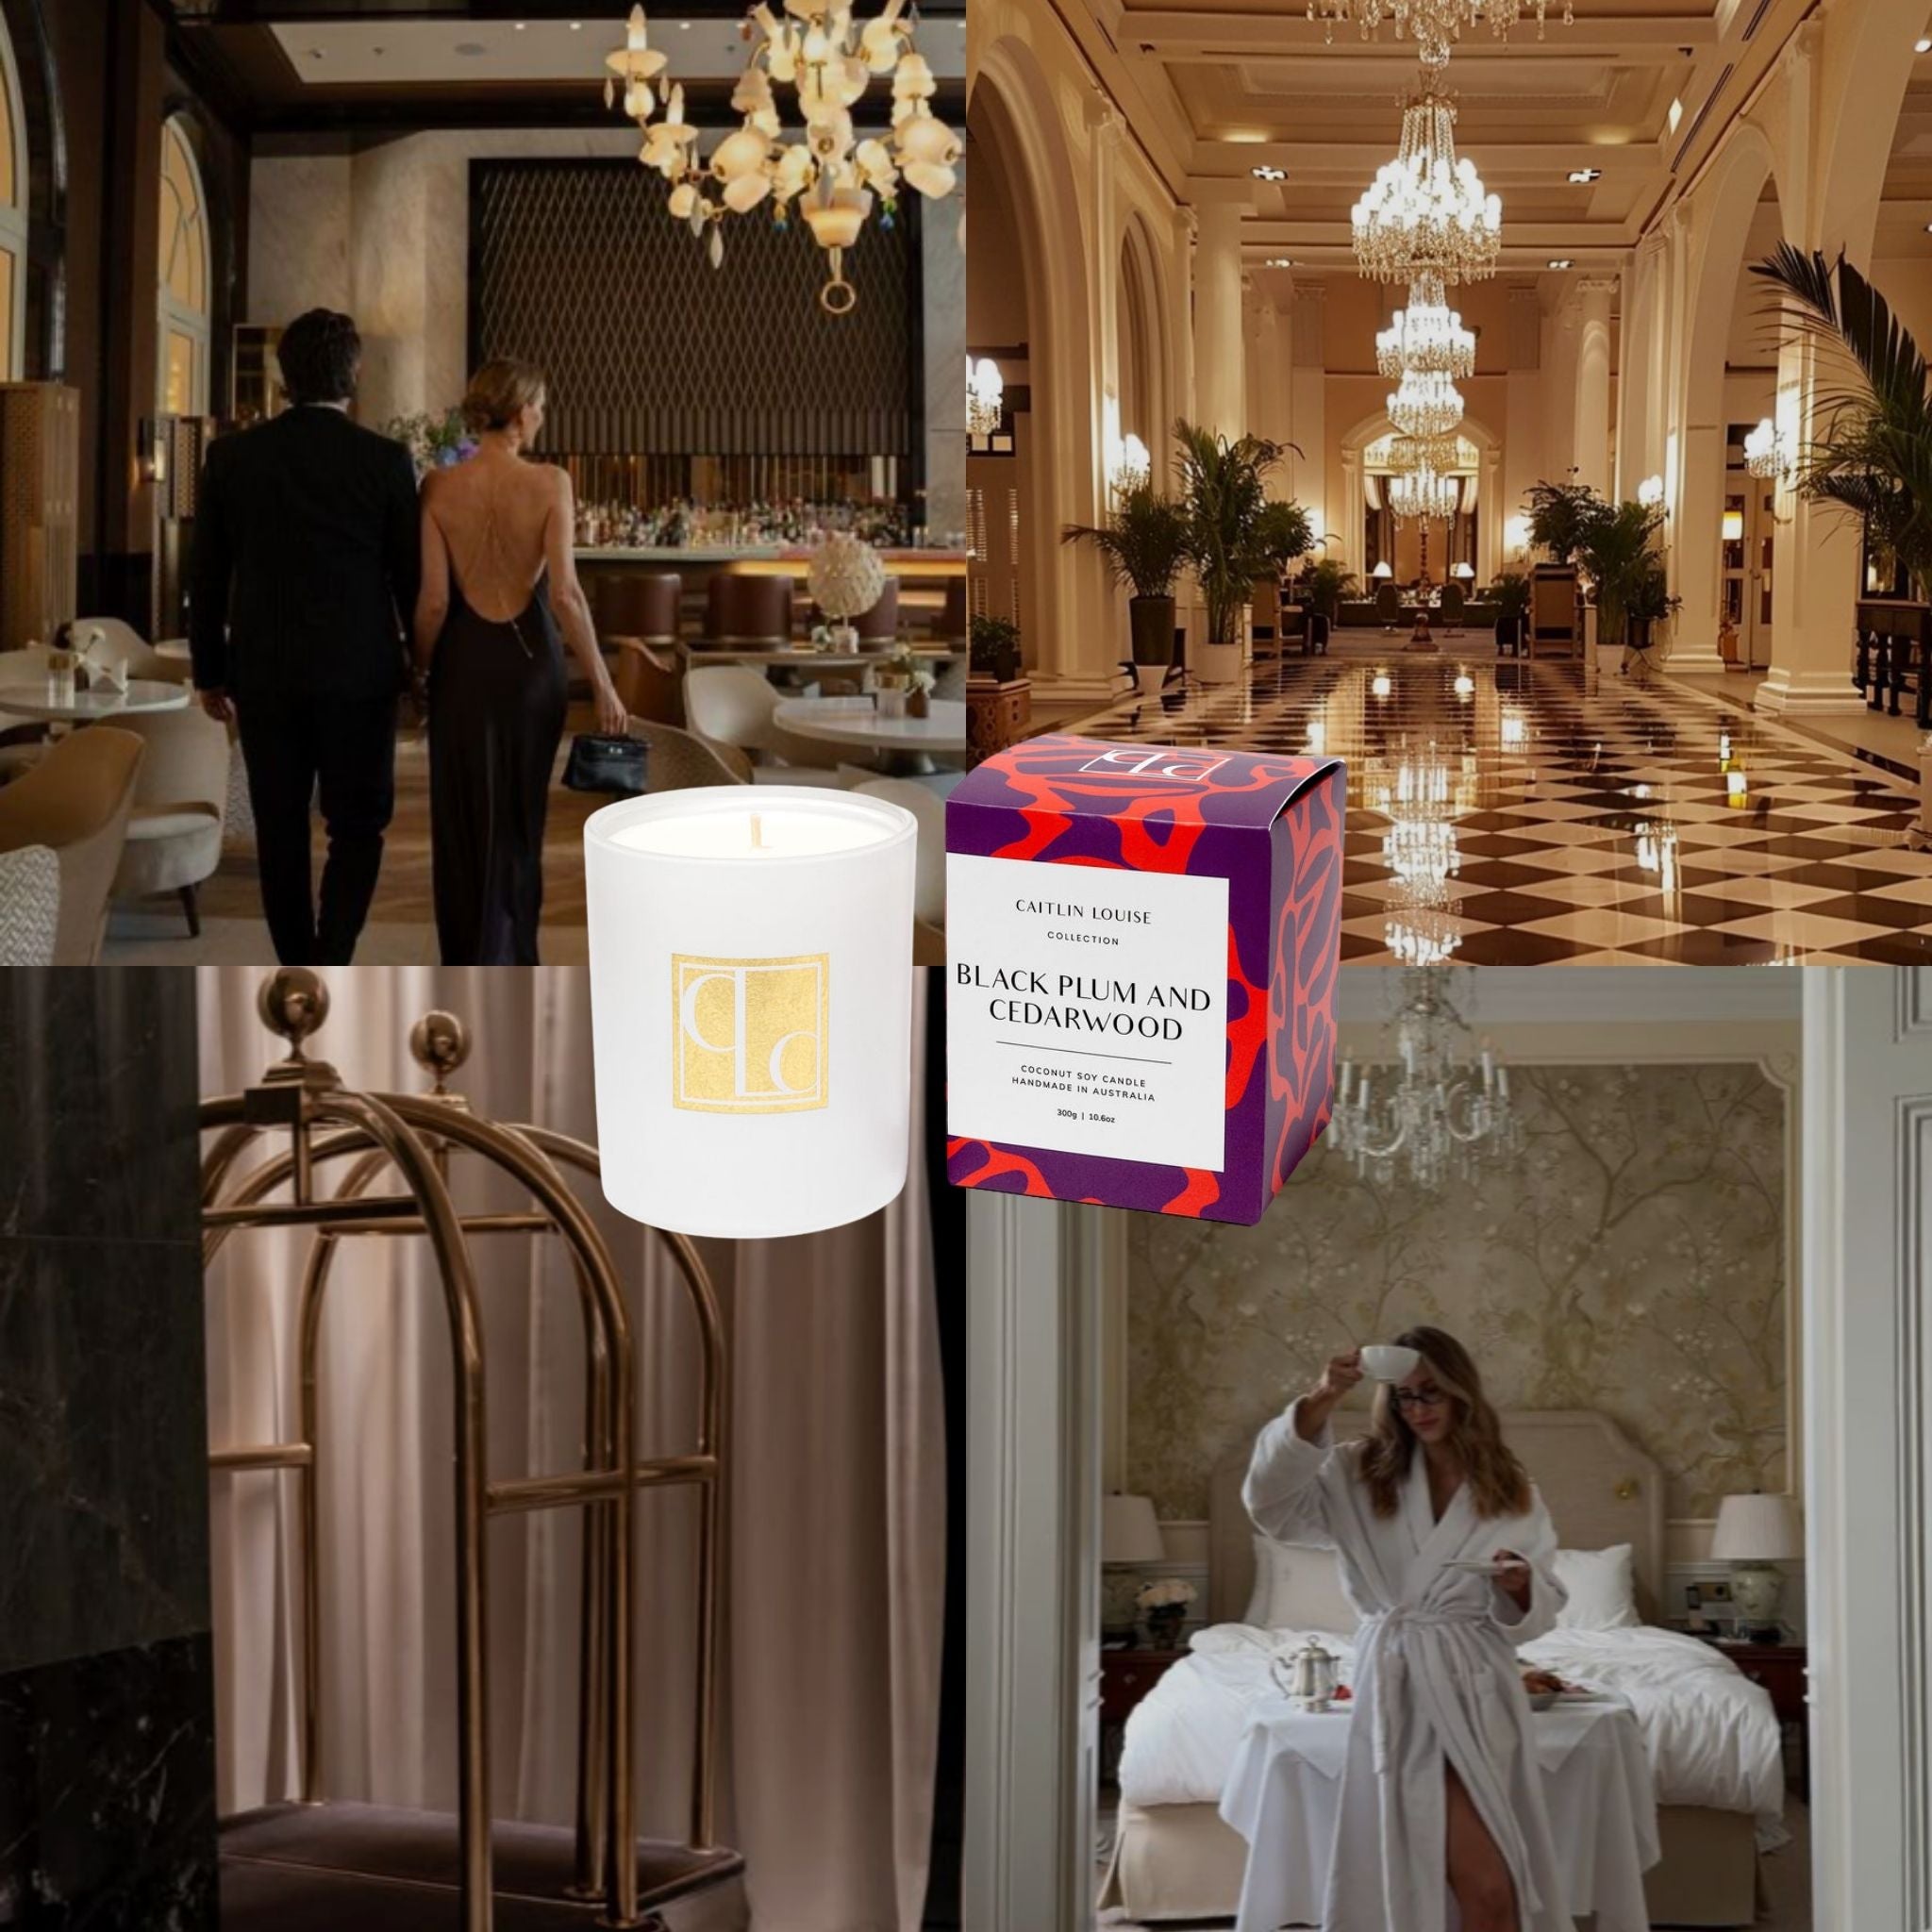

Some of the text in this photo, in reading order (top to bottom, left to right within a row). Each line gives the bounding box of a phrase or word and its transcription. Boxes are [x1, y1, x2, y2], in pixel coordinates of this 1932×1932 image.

[1014, 898, 1153, 925] CAITLIN LOUISE
[1046, 930, 1120, 946] COLLECTION
[956, 962, 1212, 1012] BLACK PLUM AND
[988, 998, 1184, 1041] CEDARWOOD
[1011, 1076, 1156, 1102] HANDMADE IN AUSTRALIA
[1020, 1064, 1147, 1088] COCONUT SOY CANDLE
[1056, 1108, 1078, 1121] 300g
[1088, 1112, 1117, 1124] 10.6oz
